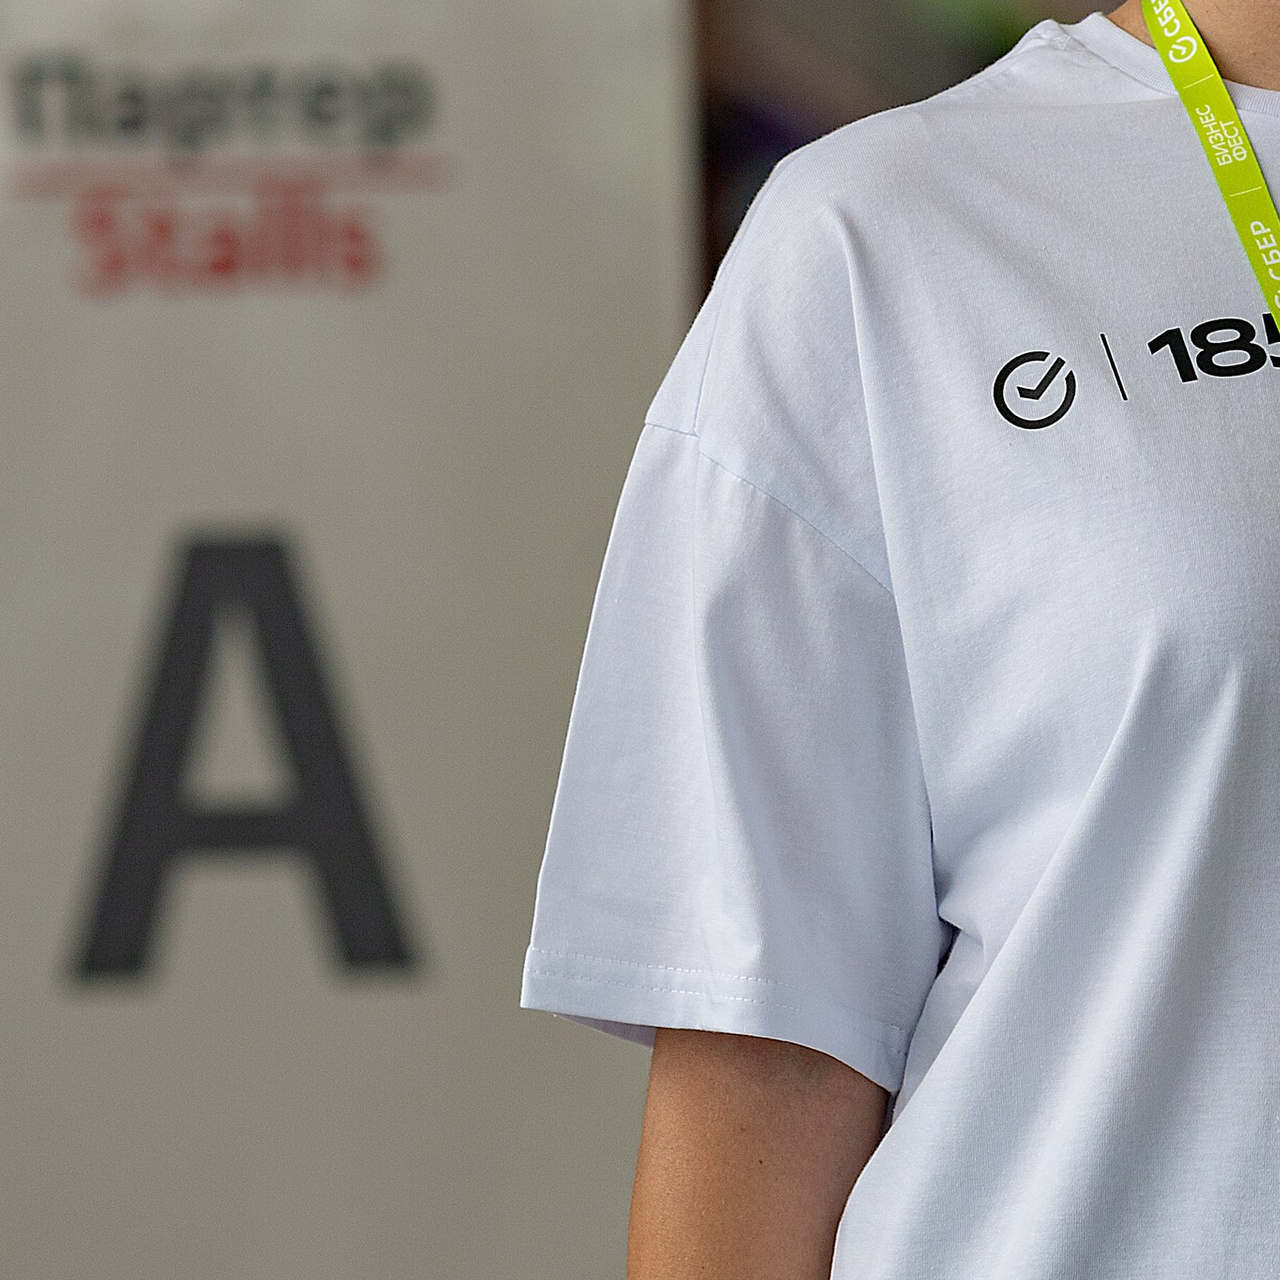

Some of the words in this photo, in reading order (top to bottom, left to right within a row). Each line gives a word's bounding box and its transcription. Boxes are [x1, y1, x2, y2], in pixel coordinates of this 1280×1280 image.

[1195, 104, 1233, 166] БИЗНЕС
[1219, 120, 1247, 162] ФЕСТ
[75, 534, 420, 983] A
